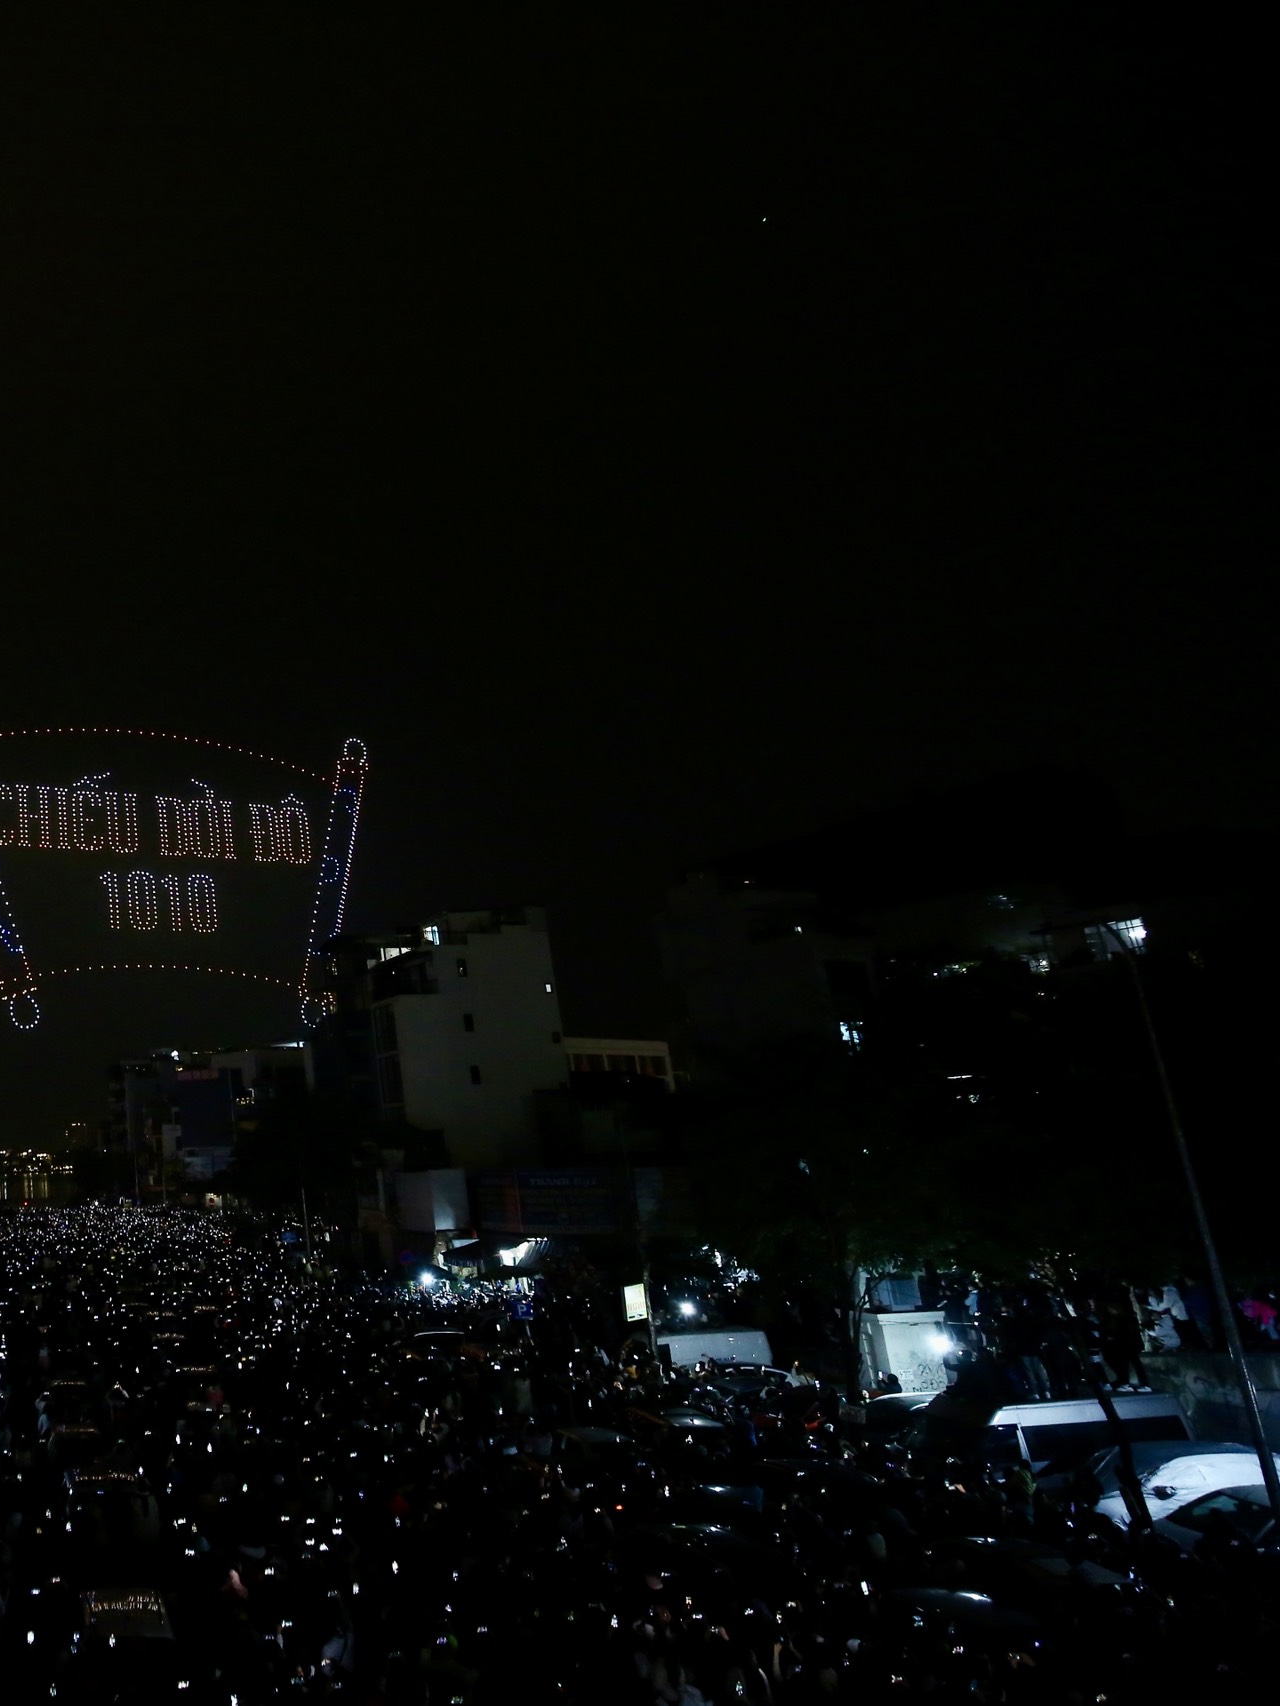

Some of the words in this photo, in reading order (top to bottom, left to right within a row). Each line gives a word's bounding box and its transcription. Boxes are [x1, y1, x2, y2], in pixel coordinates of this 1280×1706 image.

[248, 792, 314, 865] ĐÔ
[98, 869, 219, 933] 1010
[517, 1304, 527, 1316] P
